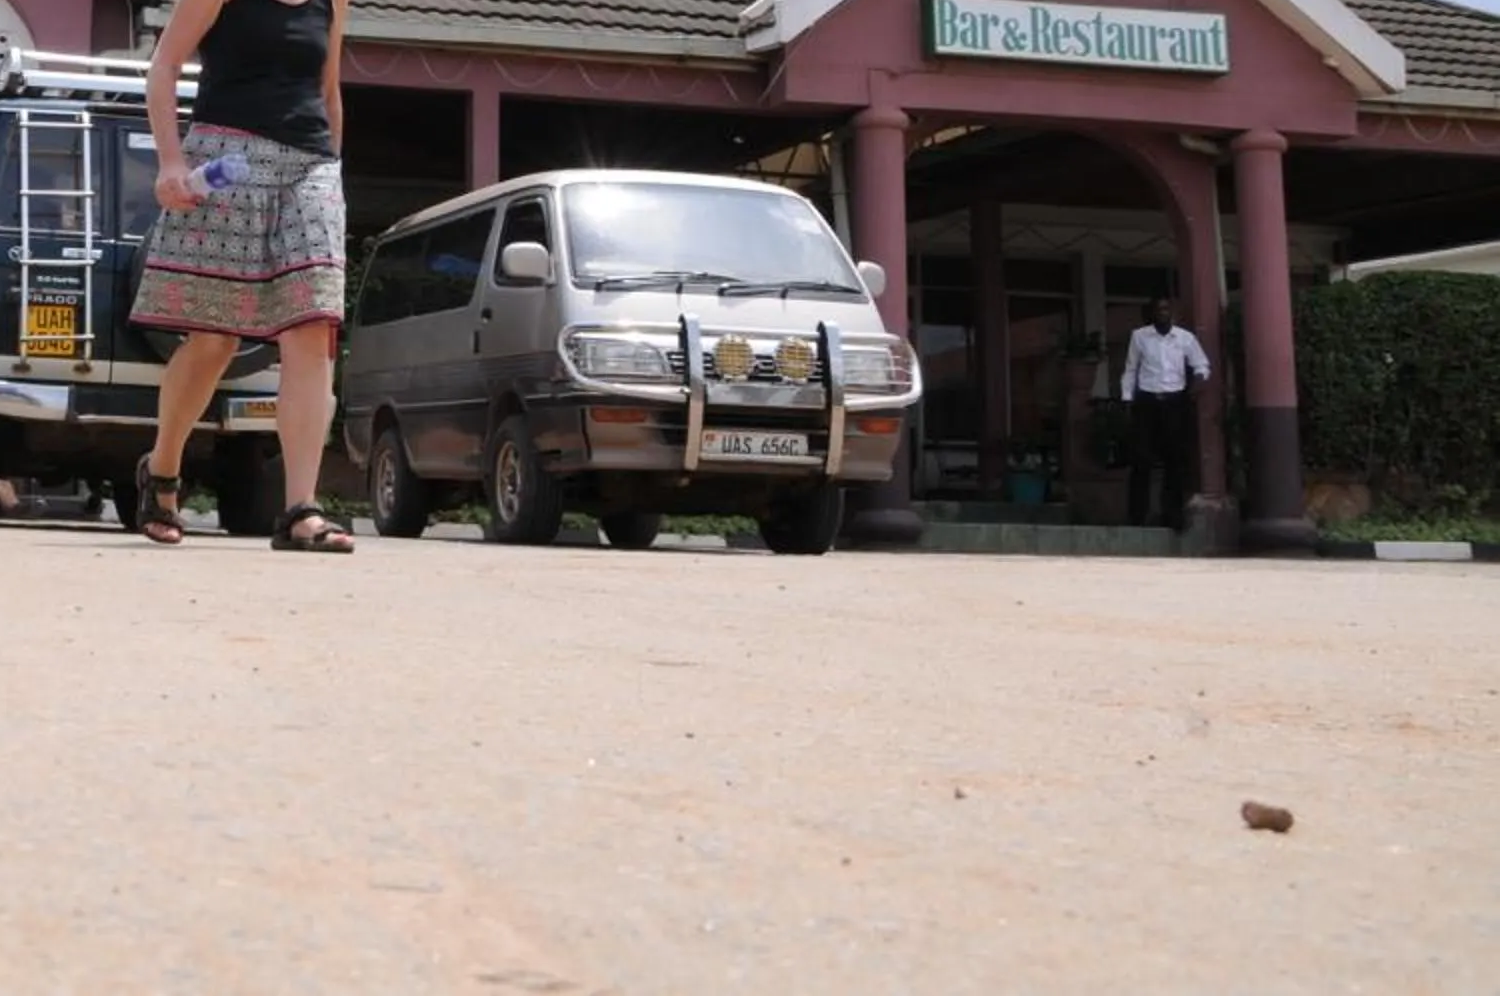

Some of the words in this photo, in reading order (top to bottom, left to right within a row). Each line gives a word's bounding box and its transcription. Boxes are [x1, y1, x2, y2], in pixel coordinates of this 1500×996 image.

[36, 308, 71, 329] UAH
[721, 435, 752, 454] UAS
[761, 436, 799, 457] 656C
